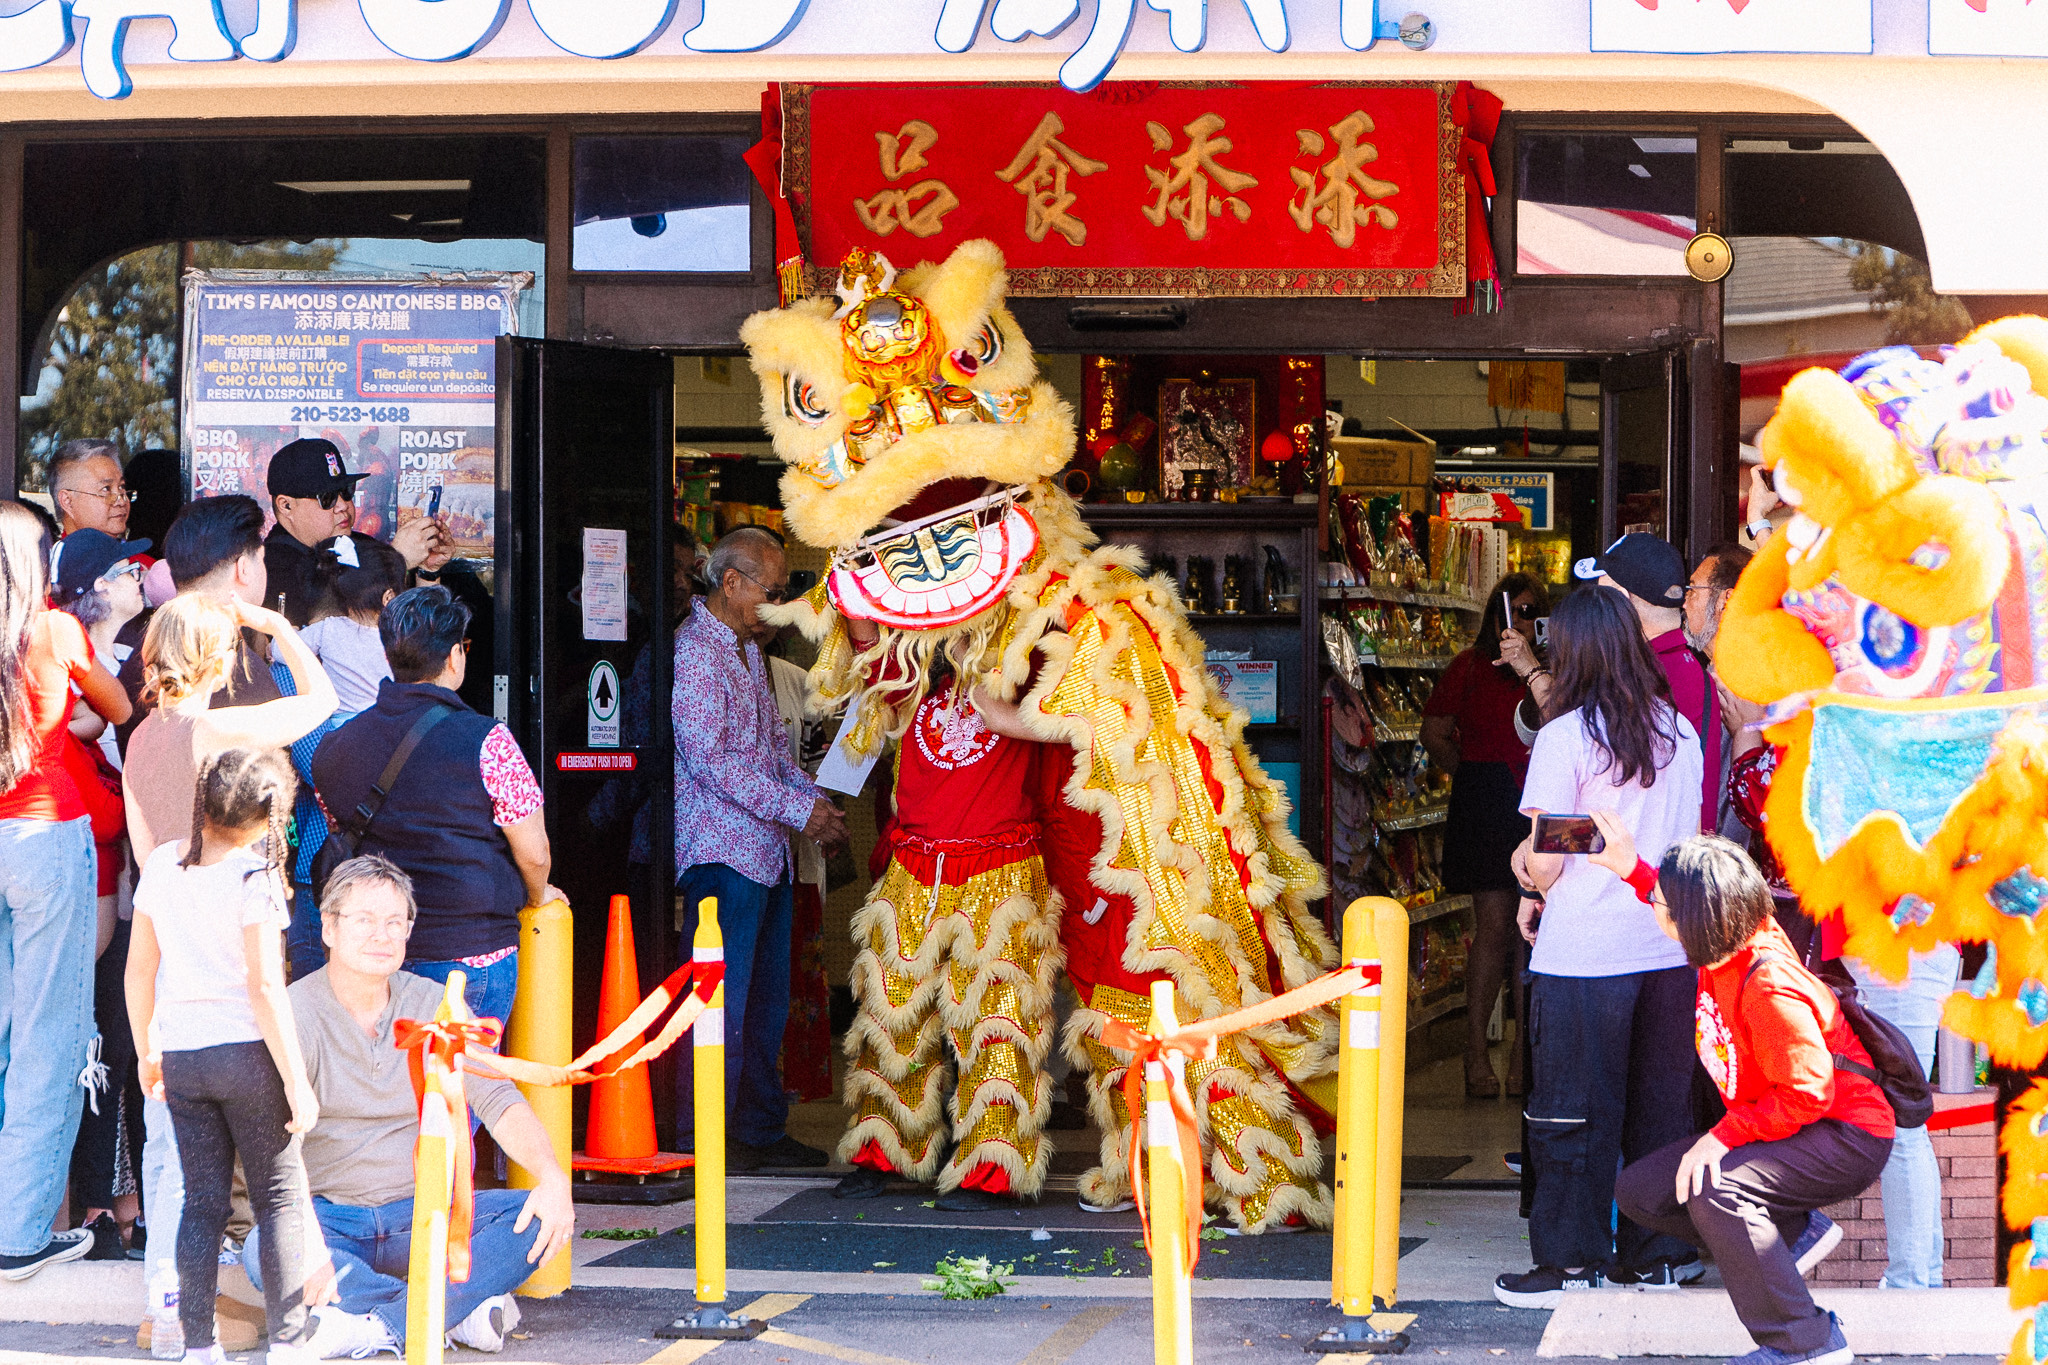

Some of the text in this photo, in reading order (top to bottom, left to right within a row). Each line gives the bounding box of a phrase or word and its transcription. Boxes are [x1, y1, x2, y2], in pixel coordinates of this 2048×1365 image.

[205, 294, 502, 312] TIM'S FAMOUS CANTONESE BBQ
[202, 335, 272, 346] PRE-ORDER
[382, 343, 478, 355] Deposit Required
[406, 355, 453, 367] 需要存款
[215, 375, 246, 386] CHO
[362, 382, 495, 394] Se requiere un depósito
[207, 389, 344, 400] RESERVA DISPONIBLE
[290, 407, 410, 423] 210-523-1688
[196, 429, 240, 451] BBQ
[400, 430, 467, 449] ROAST
[196, 451, 250, 468] PORK
[400, 452, 457, 470] PORK
[1512, 476, 1548, 485] PASTA
[1236, 662, 1273, 670] WINNER
[916, 703, 928, 724] SAN
[914, 723, 936, 762] ANTONIO
[568, 755, 597, 768] EMERGENCY
[598, 755, 611, 768] PUSH
[611, 755, 618, 768] TO
[619, 755, 632, 768] OPEN
[932, 759, 954, 771] LION
[1562, 1279, 1590, 1290] HOKA
